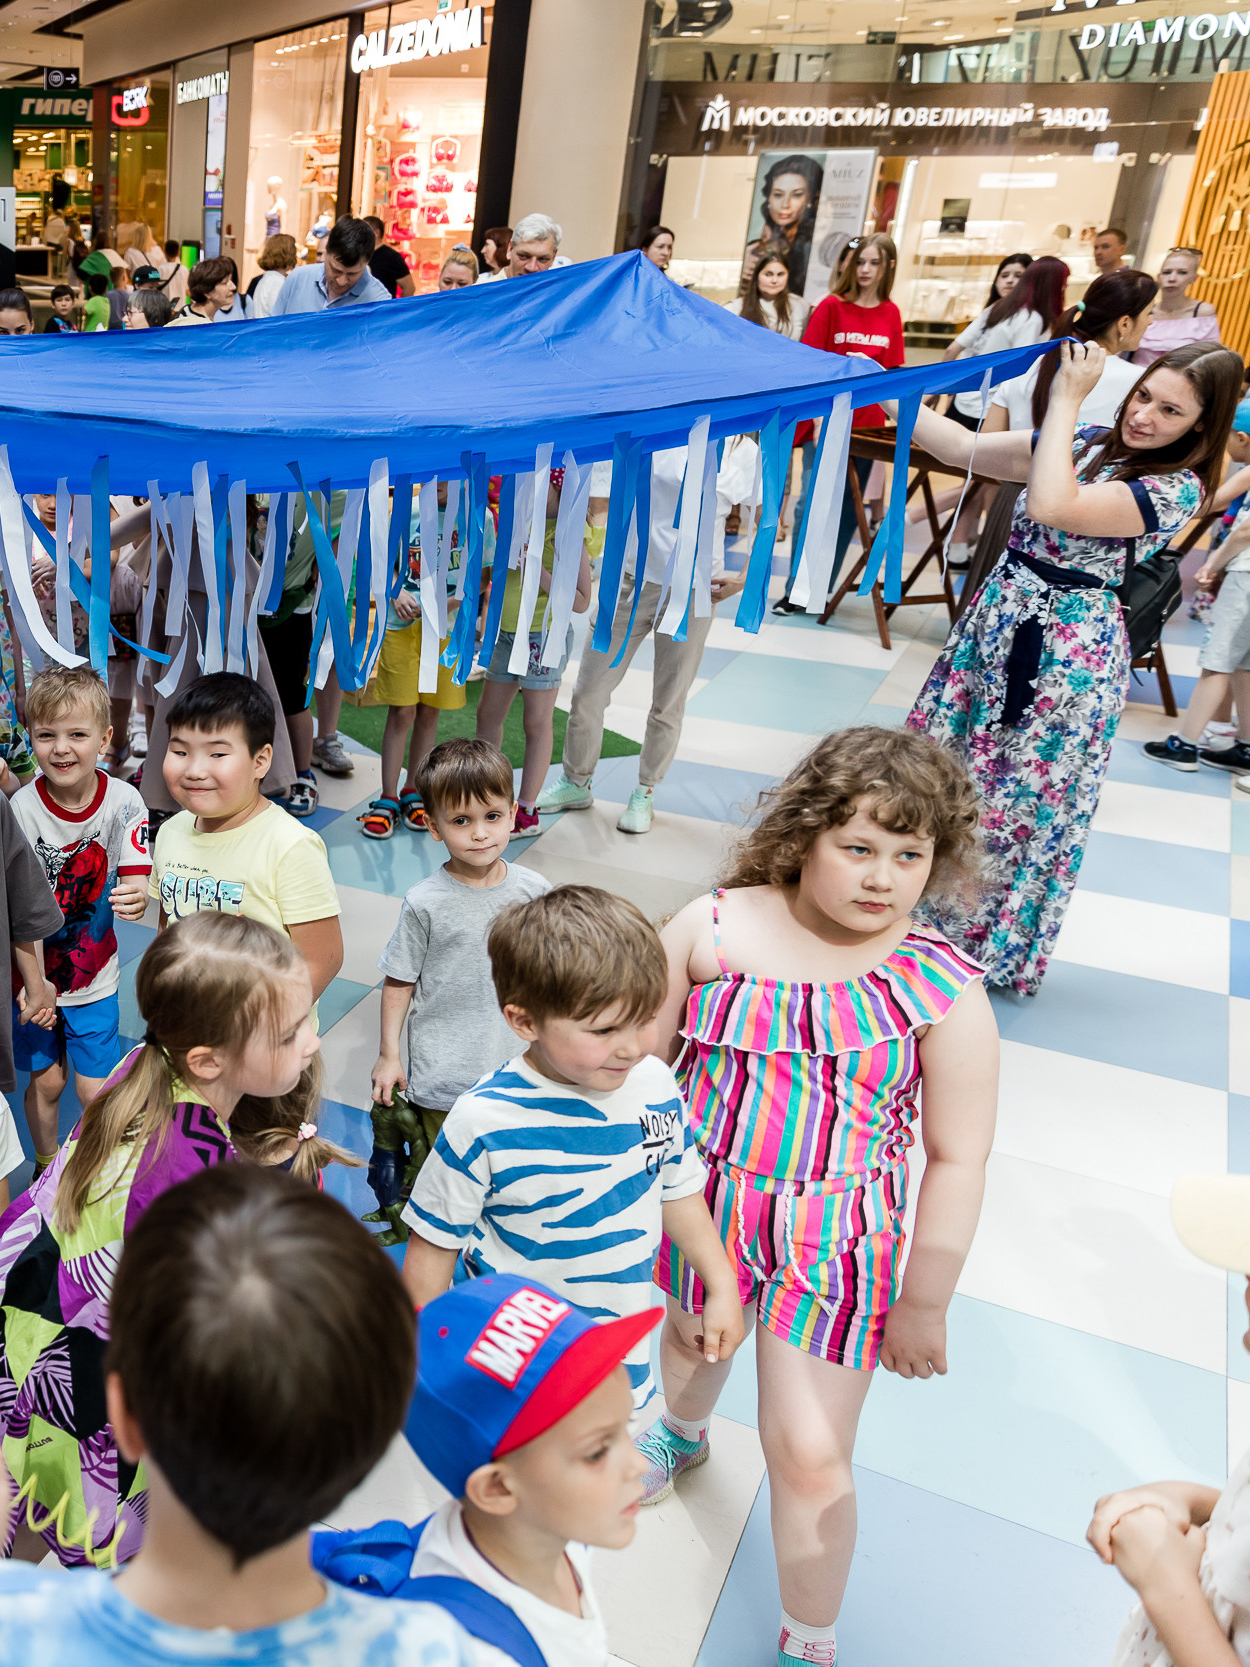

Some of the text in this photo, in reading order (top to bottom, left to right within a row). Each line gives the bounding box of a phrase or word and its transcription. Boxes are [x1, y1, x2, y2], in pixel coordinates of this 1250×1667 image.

[351, 5, 483, 73] CALZEDONIA
[177, 71, 230, 104] БАНКОМАТЫ
[733, 102, 1110, 131] МОСКОВСКИЙ ЮВЕЛИРНЫЙ ЗАВОД
[0, 198, 6, 222] 1
[638, 1112, 678, 1141] NOISY
[470, 1288, 570, 1382] MARVEL
